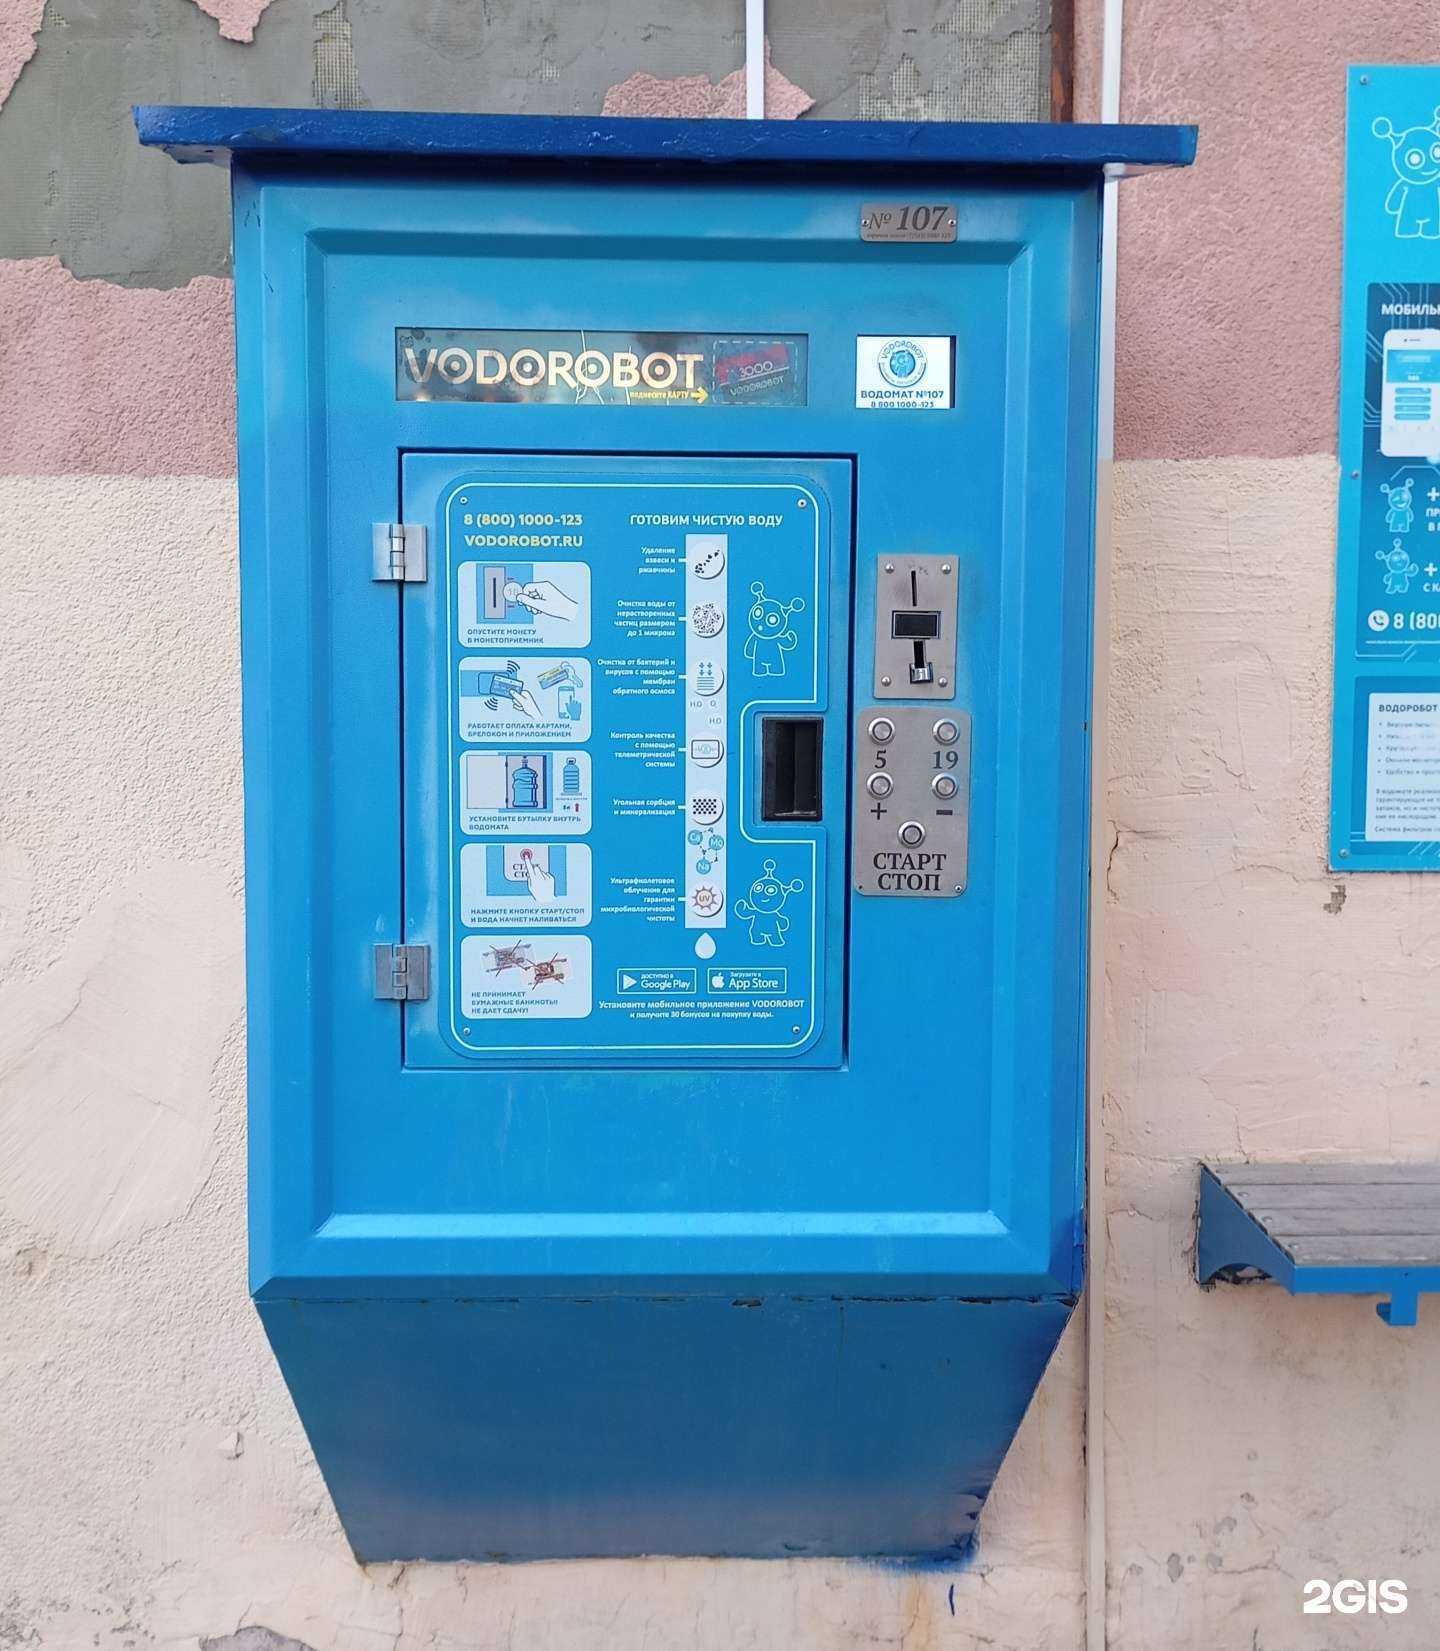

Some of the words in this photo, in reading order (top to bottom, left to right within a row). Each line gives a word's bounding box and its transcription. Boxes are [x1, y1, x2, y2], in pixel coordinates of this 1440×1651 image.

[896, 206, 947, 231] 107
[404, 346, 704, 389] VODOROBOT
[861, 390, 914, 400] ВОДОМАТ
[463, 514, 473, 526] 8
[476, 514, 515, 528] (800)
[519, 514, 583, 526] 1000-123
[630, 515, 690, 526] ГОТОВИМ
[692, 515, 745, 526] ЧИСТУЮ
[748, 515, 783, 528] ВОДУ
[464, 535, 583, 547] VODOROBOT.RU
[641, 547, 676, 555] Удаление
[647, 601, 666, 609] воды
[614, 620, 638, 628] частиц
[639, 620, 676, 628] размером
[1393, 612, 1404, 629] 8
[1410, 611, 1440, 631] (80
[644, 630, 676, 638] микрона
[636, 659, 669, 667] бактерий
[640, 669, 676, 677] помощью
[612, 688, 649, 696] обратного
[1378, 704, 1437, 712] ВОДОРОБОТ
[610, 732, 644, 740] Контроль
[640, 742, 676, 750] помощью
[874, 750, 887, 769] 5
[932, 750, 959, 769] 19
[646, 799, 676, 807] сорбция
[468, 815, 517, 823] УСТАНОВИТЕ
[518, 815, 551, 823] БУТЫЛКУ
[873, 852, 947, 870] СТАРТ
[877, 872, 942, 891] СТОП
[623, 886, 661, 895] облучение
[699, 895, 711, 903] UV
[600, 906, 676, 914] микробиологической
[641, 979, 672, 991] Google
[673, 979, 690, 991] Play
[729, 978, 751, 991] App
[751, 978, 779, 989] Store
[599, 1000, 646, 1008] Установите
[647, 1000, 696, 1008] мобильное
[697, 1001, 750, 1009] приложение
[752, 1000, 805, 1008] VODOROBOT
[680, 1010, 710, 1019] бонусов
